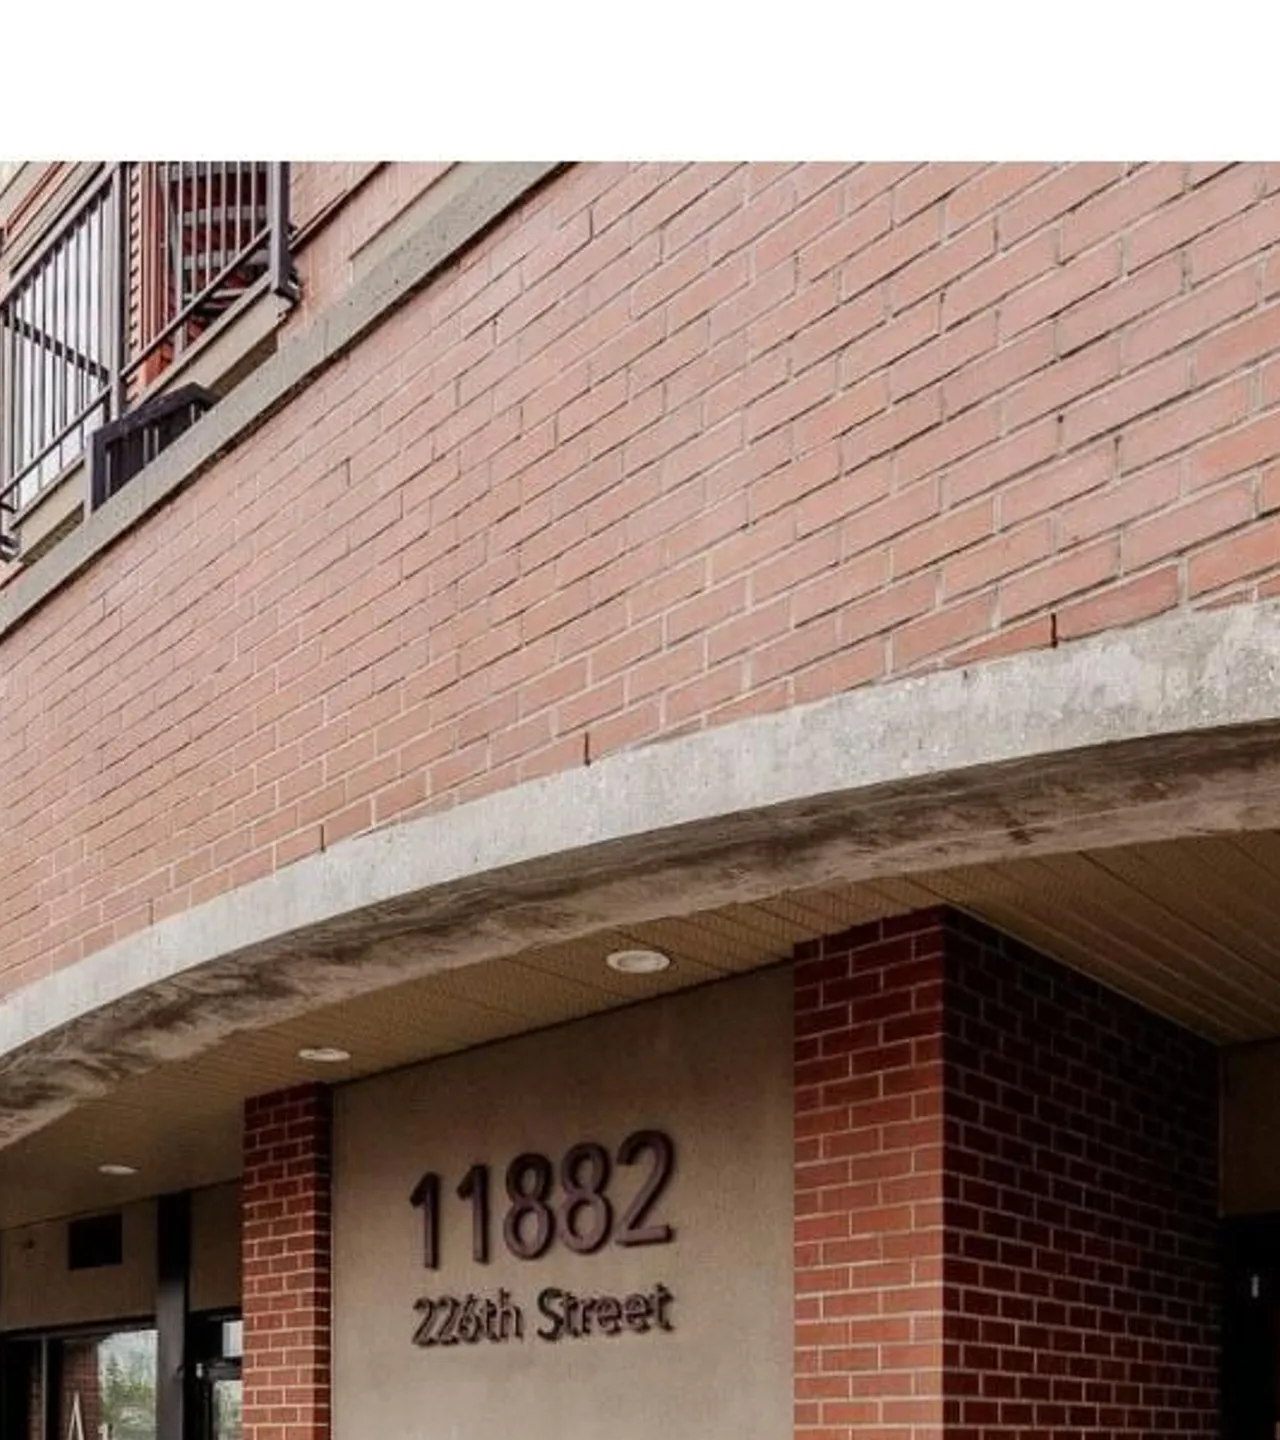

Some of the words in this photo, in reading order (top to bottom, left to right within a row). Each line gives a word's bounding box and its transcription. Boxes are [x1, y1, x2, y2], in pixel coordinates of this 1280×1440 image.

[409, 1129, 677, 1271] 11882
[411, 1288, 524, 1347] 226th
[537, 1283, 676, 1341] Street
